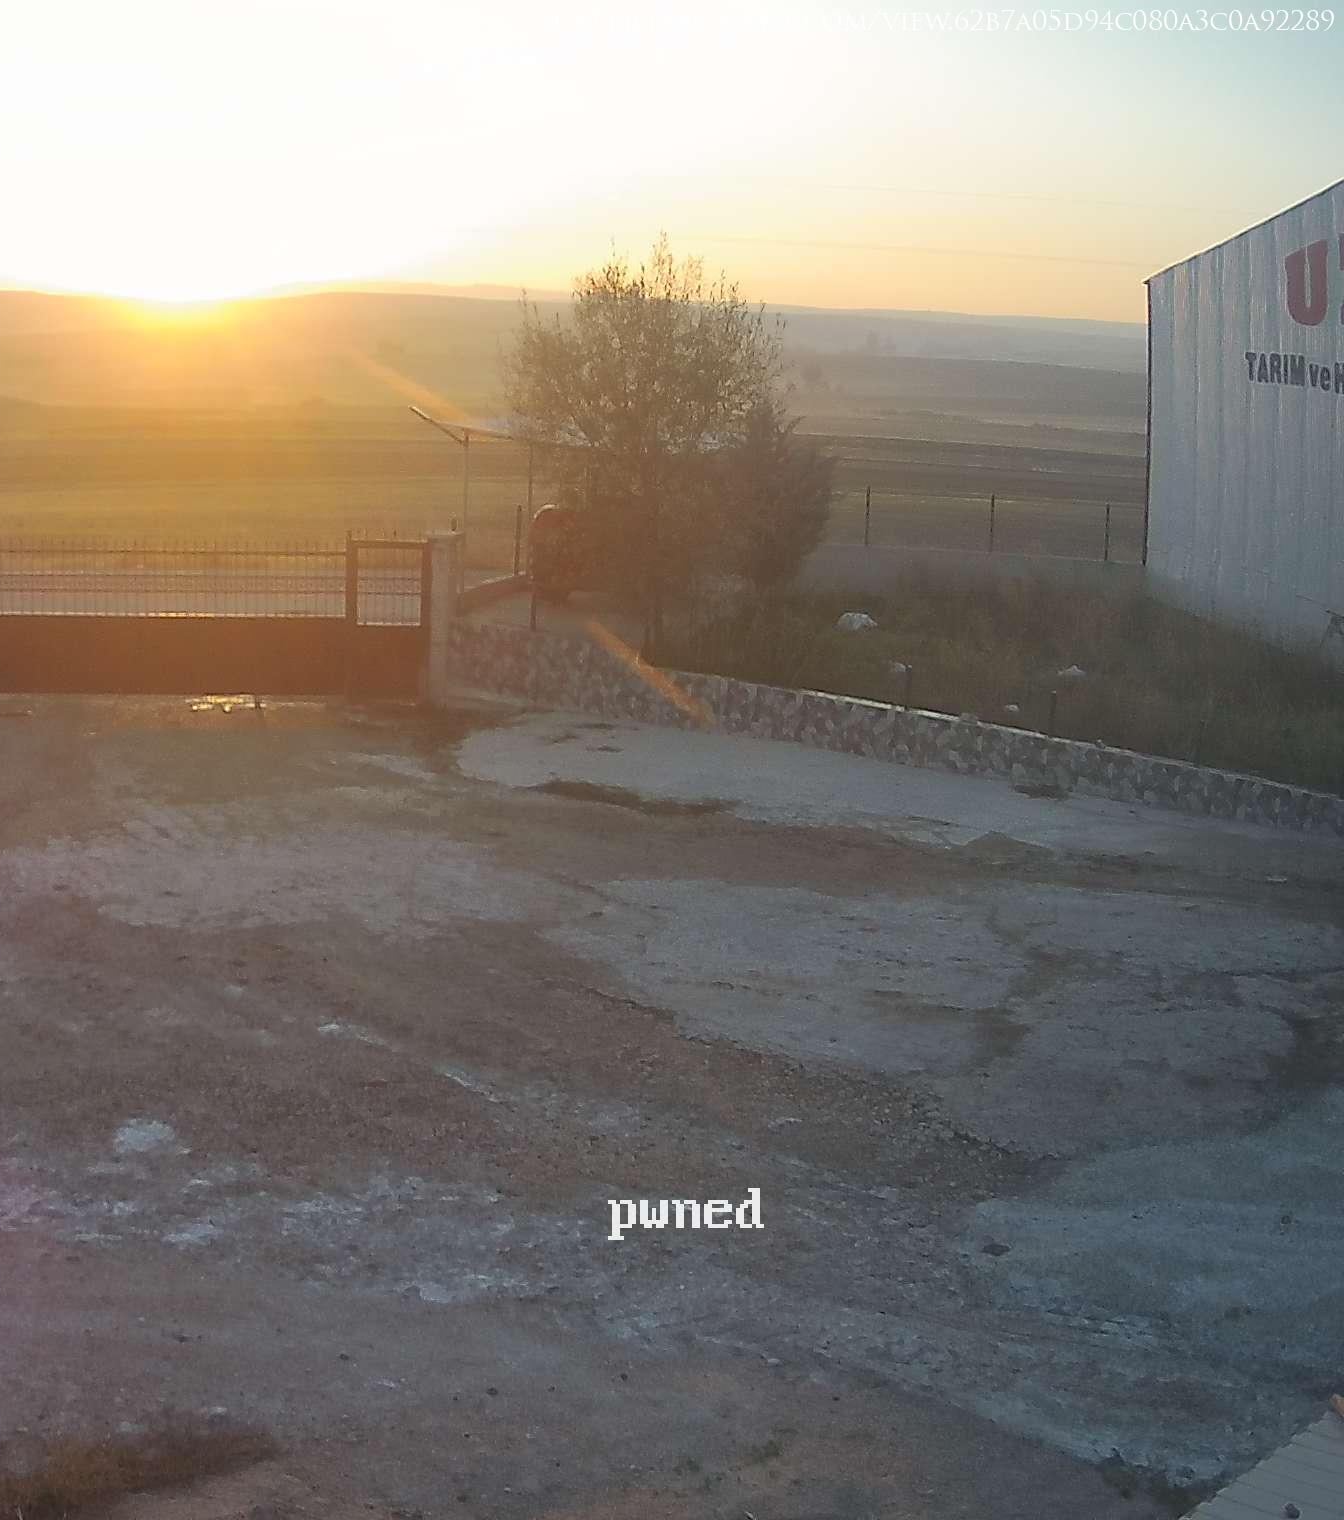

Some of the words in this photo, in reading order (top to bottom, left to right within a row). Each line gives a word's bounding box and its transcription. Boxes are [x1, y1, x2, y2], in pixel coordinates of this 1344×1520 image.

[1285, 233, 1344, 326] U
[1244, 351, 1306, 387] TARIM
[1309, 362, 1332, 392] ve
